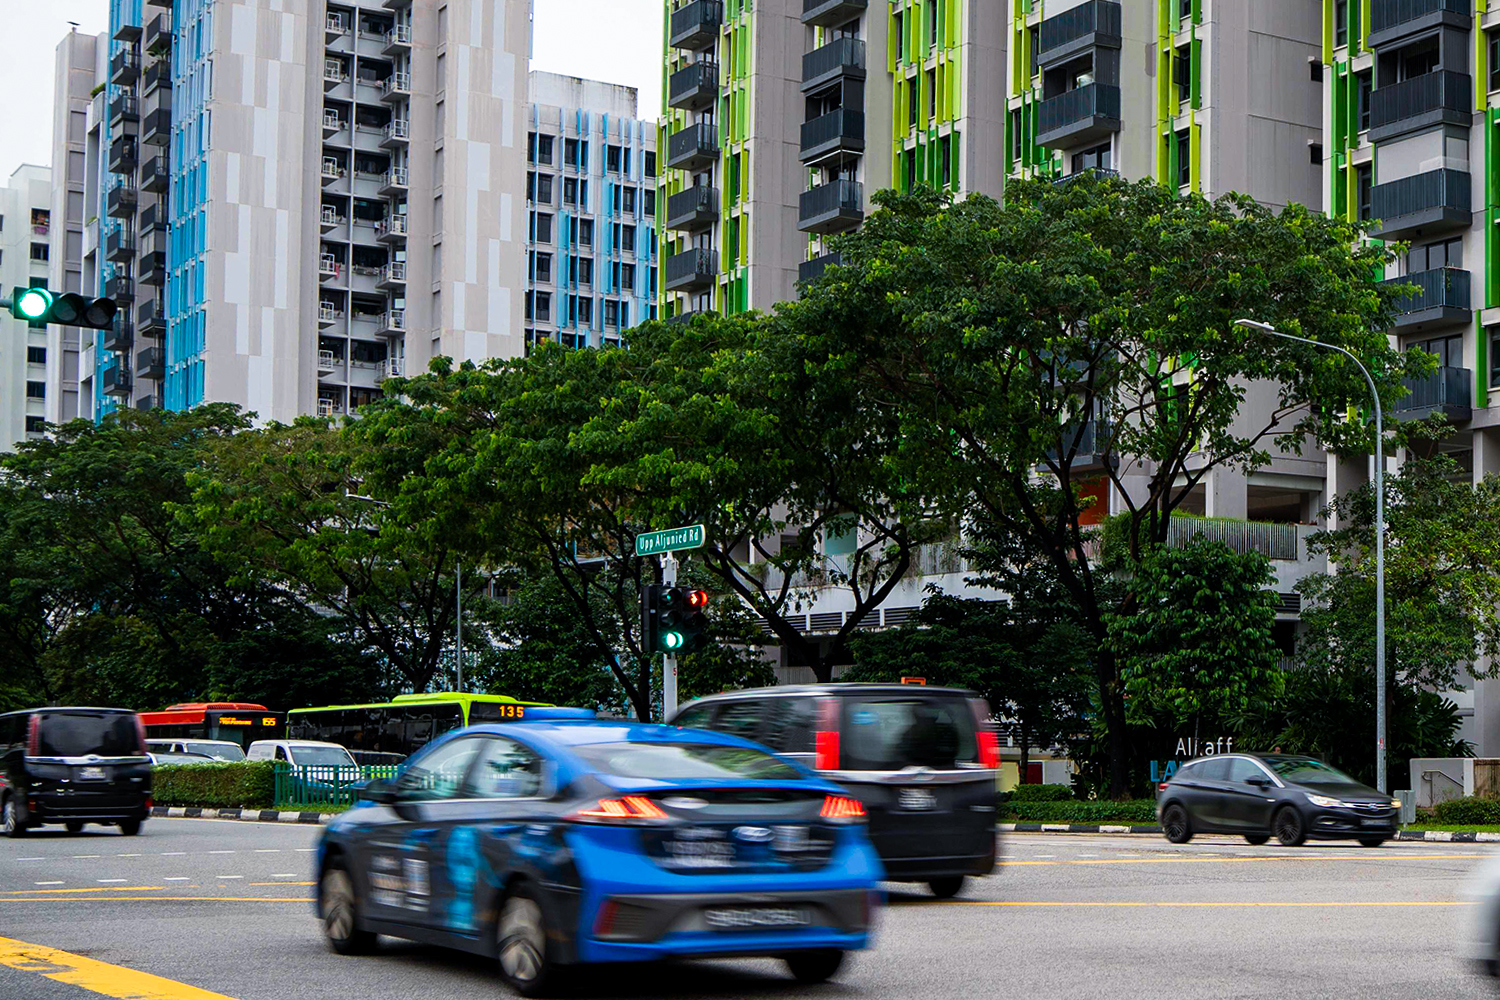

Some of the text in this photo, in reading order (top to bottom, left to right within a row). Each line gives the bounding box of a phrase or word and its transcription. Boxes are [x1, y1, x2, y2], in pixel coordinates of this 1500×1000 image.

[640, 528, 699, 552] Upp Aljunied Rd
[499, 705, 524, 718] 135
[1150, 760, 1184, 782] LA
